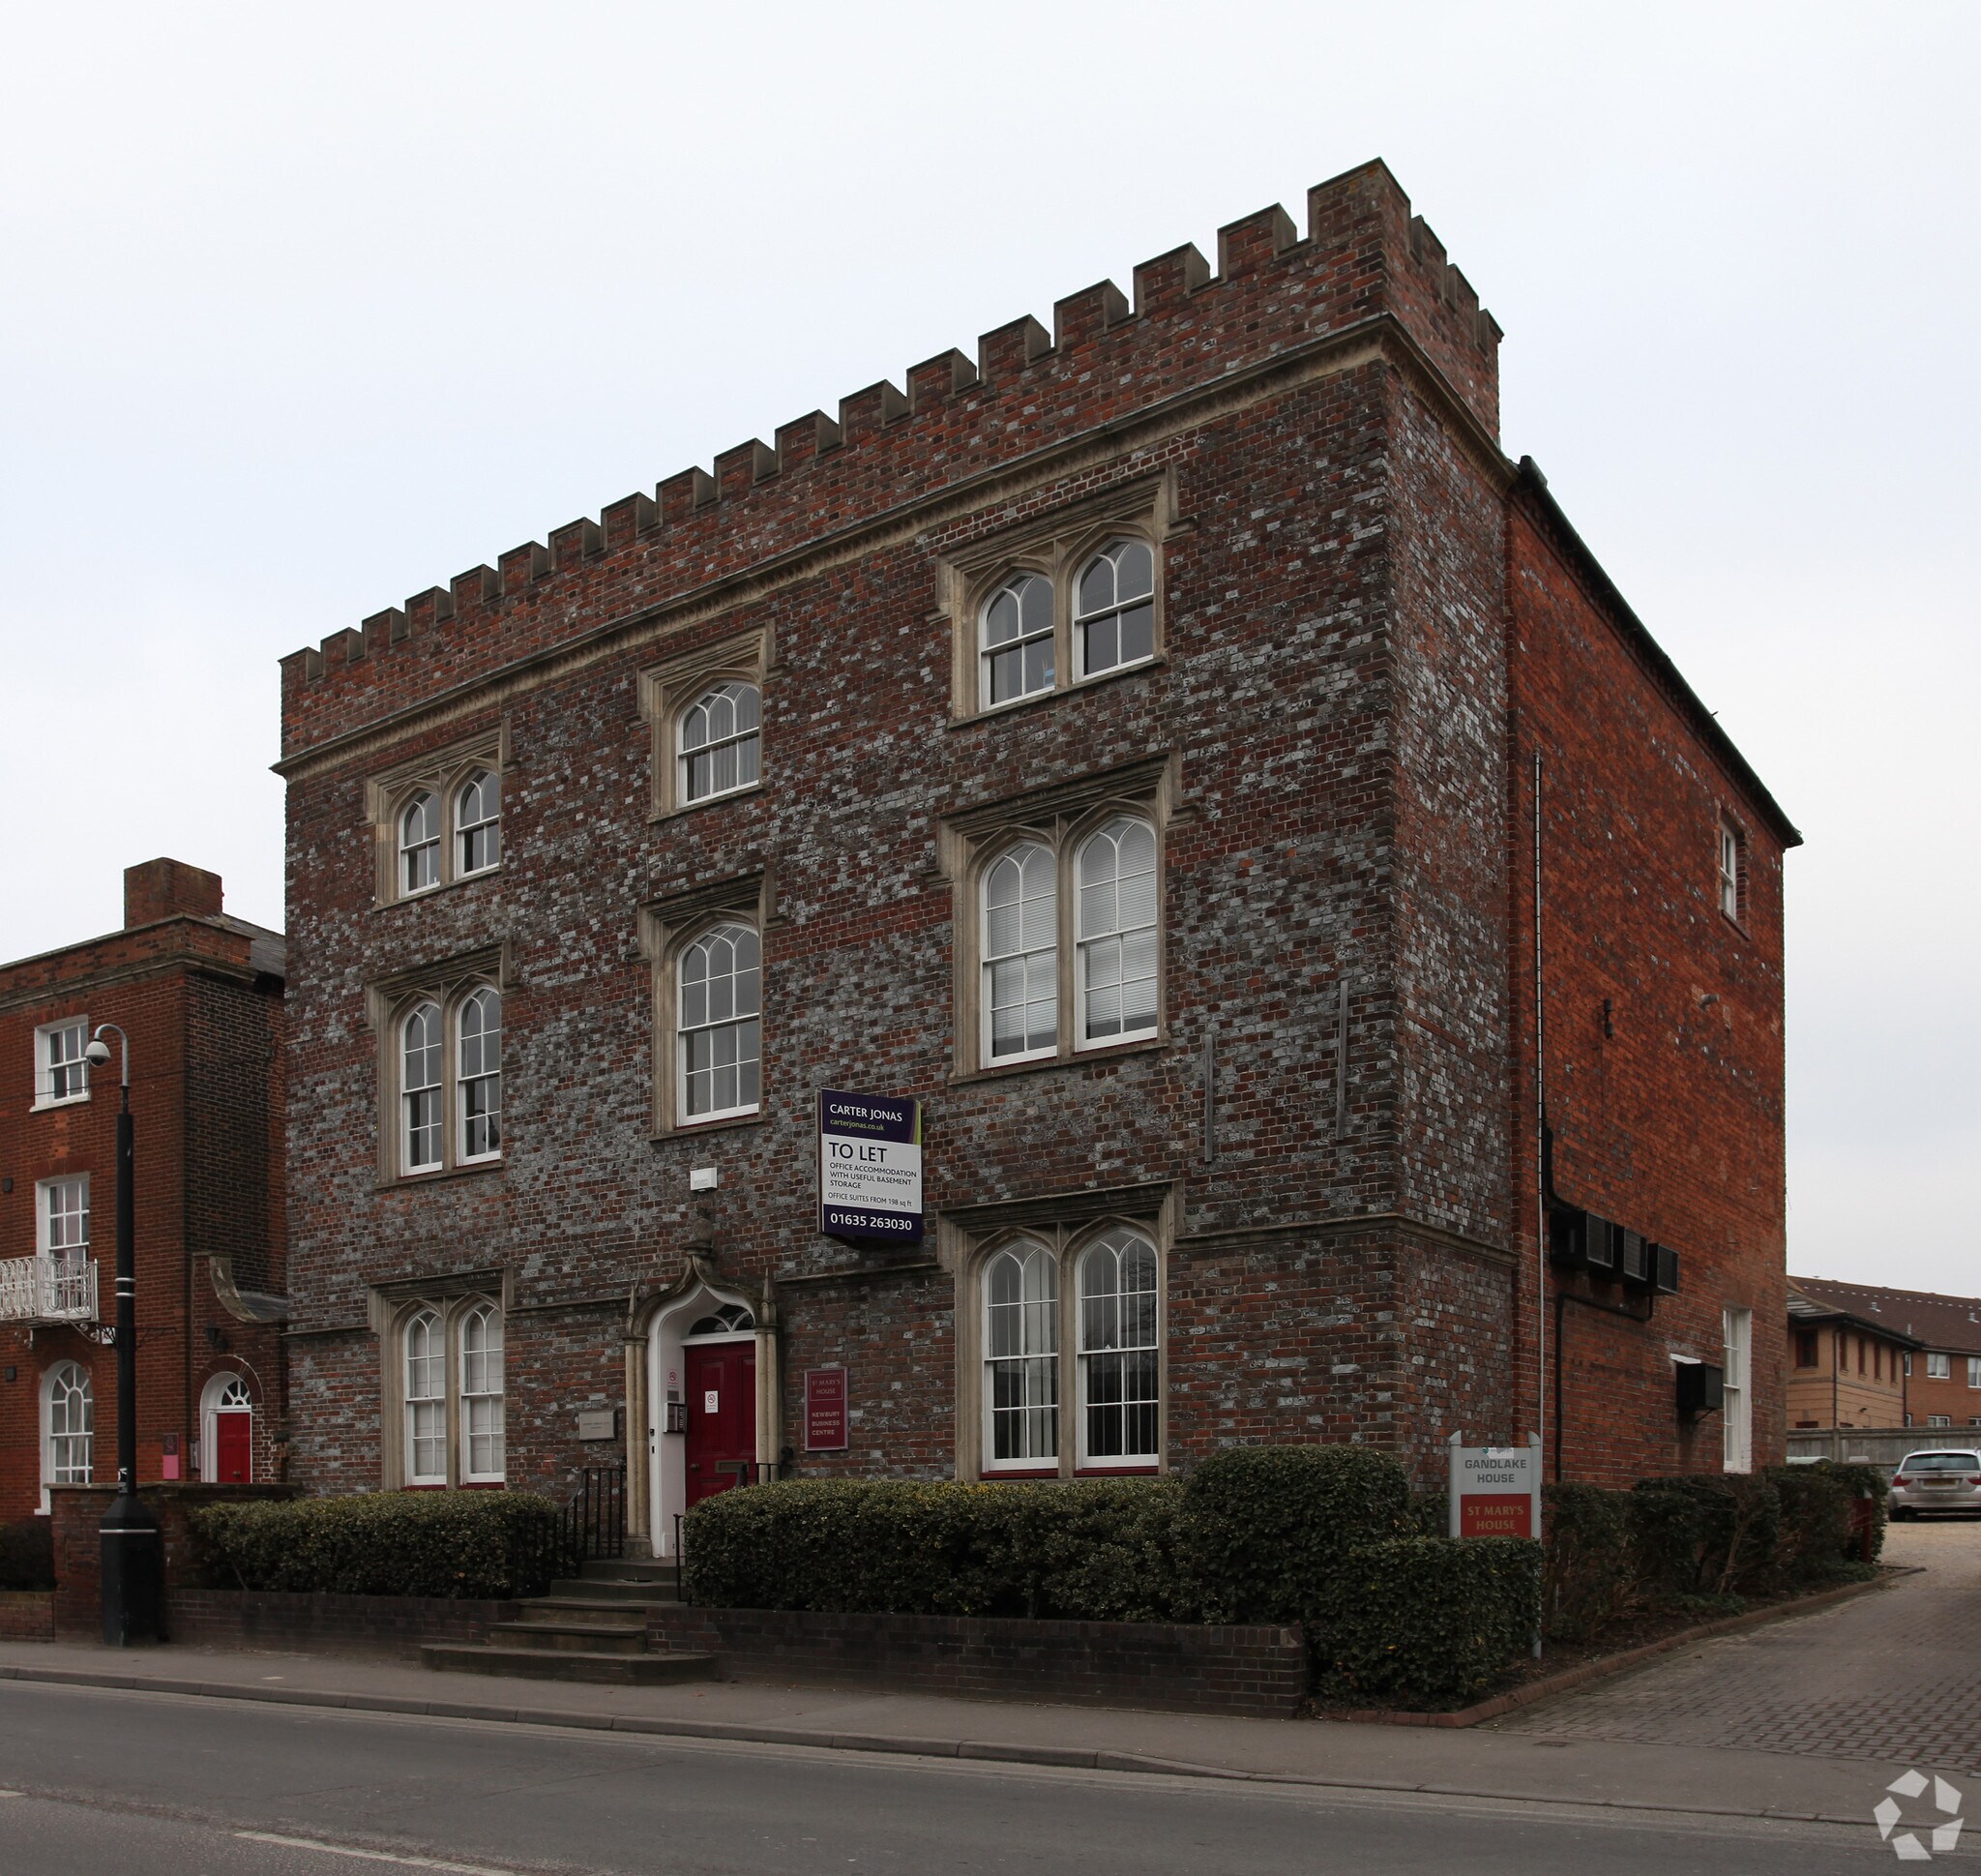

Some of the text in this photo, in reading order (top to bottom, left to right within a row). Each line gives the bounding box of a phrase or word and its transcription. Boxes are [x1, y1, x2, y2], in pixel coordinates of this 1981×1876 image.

[830, 1104, 902, 1122] CARTER JONAS
[830, 1118, 885, 1131] carterjonas.co.uk
[828, 1142, 888, 1163] TO LET
[829, 1162, 917, 1177] OFFICE ACCOMMODATION
[830, 1179, 862, 1189] STORAGE
[850, 1173, 875, 1182] USEFUL
[876, 1176, 912, 1185] BASEMENT
[827, 1192, 848, 1201] OFFICE
[849, 1194, 870, 1203] SUITES
[830, 1212, 912, 1231] 01635 263030
[1464, 1459, 1527, 1470] GANDLAKE
[1477, 1474, 1515, 1483] HOUSE
[1467, 1504, 1524, 1516] ST MARY'S
[1476, 1520, 1516, 1530] HOUSE
